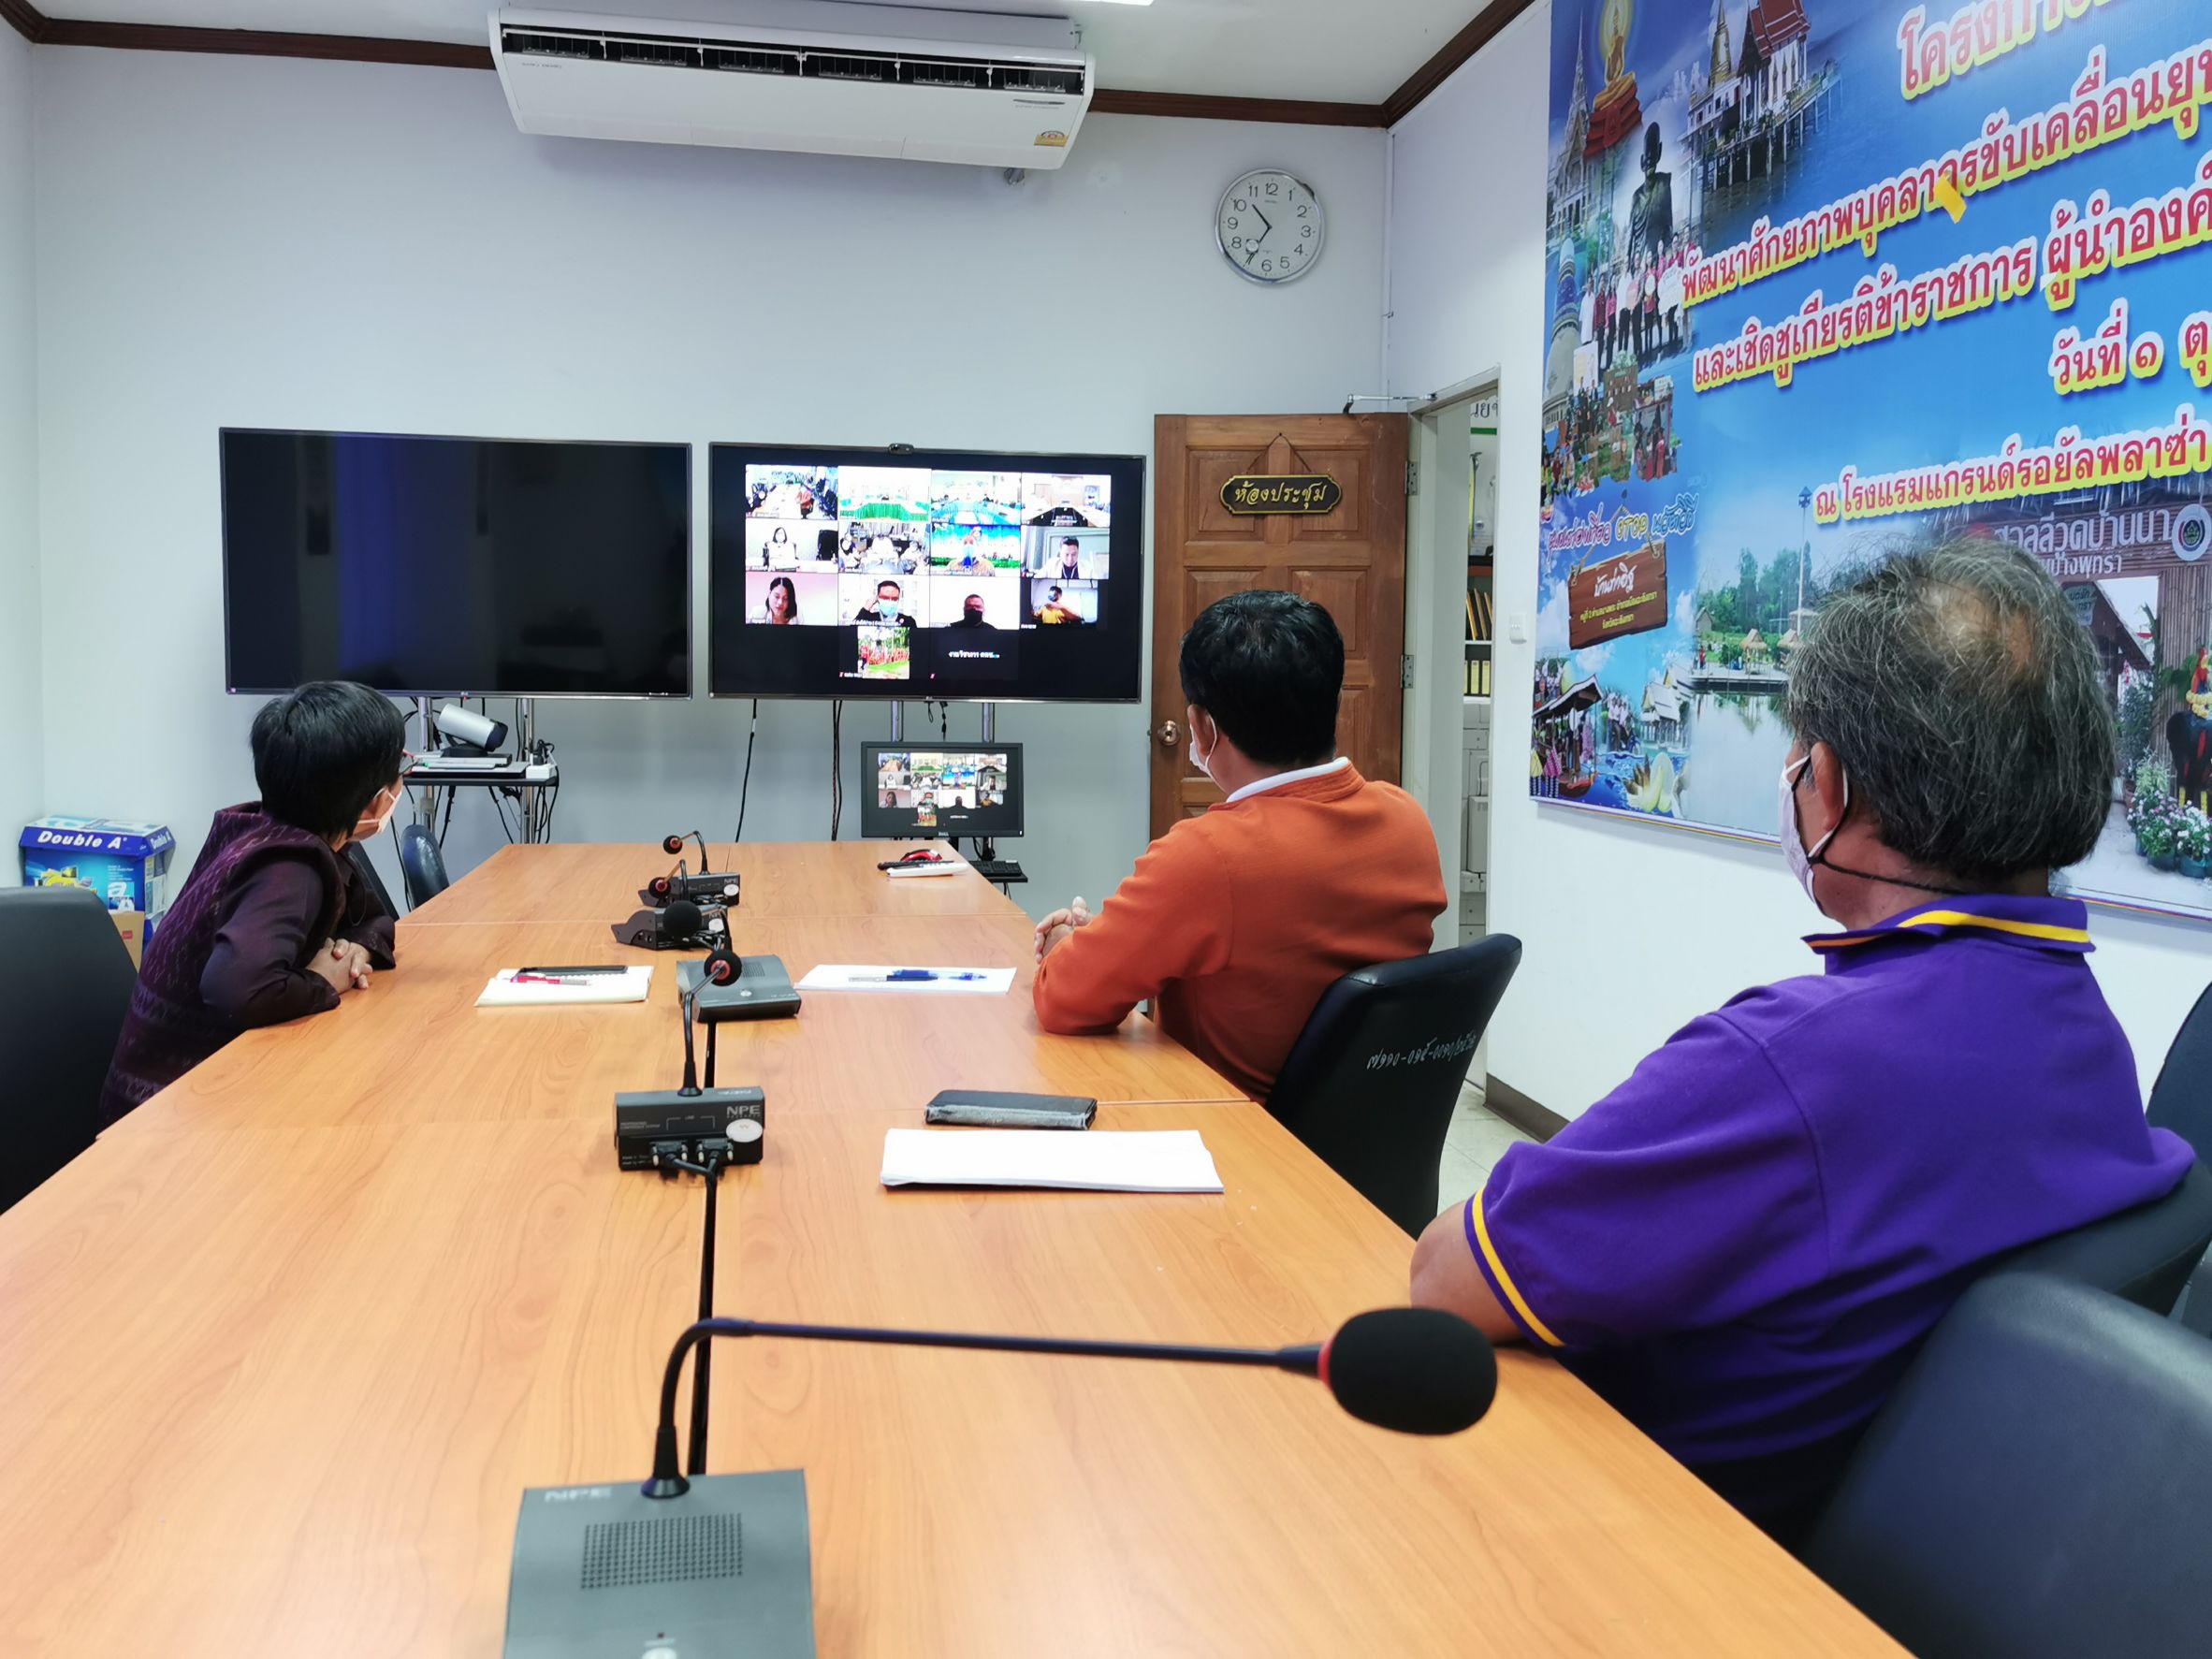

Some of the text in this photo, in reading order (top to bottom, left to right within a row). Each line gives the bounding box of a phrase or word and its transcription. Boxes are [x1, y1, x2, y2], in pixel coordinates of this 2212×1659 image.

[1248, 185, 1259, 197] 11
[1265, 182, 1279, 196] 12
[1233, 198, 1247, 211] 10
[1296, 205, 1308, 218] 2
[1227, 216, 1239, 230] 9
[1301, 225, 1312, 238] 3
[1230, 236, 1243, 249] 8
[1293, 243, 1303, 255] 4
[1261, 259, 1273, 272] 6
[1279, 255, 1290, 269] 5
[2053, 307, 2123, 386] วันที่
[1234, 479, 1328, 510] ห้องประชุม
[36, 830, 122, 850] Double A
[726, 1104, 762, 1116] NPE
